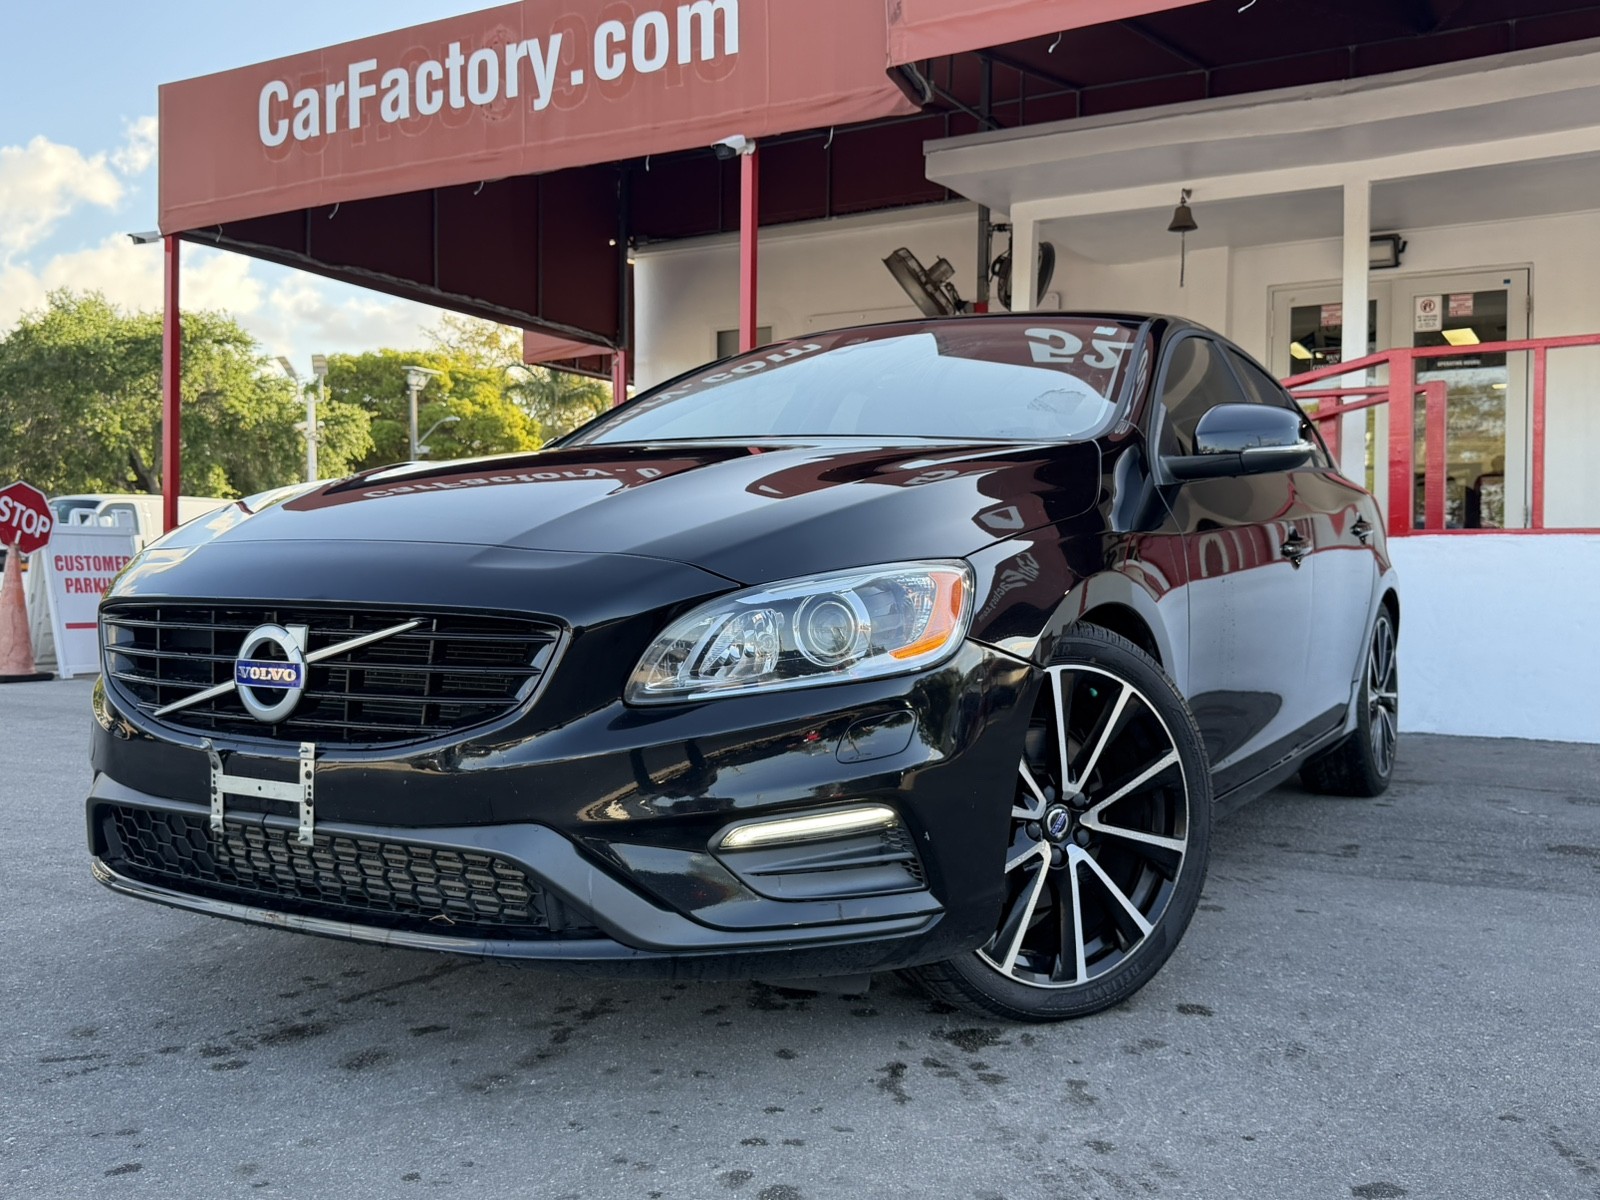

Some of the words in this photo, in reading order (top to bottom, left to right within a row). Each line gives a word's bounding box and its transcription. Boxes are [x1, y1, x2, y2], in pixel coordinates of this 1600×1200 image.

[258, 0, 738, 147] CarFactory.com
[0, 495, 51, 538] STOP
[238, 666, 297, 682] VOLVO
